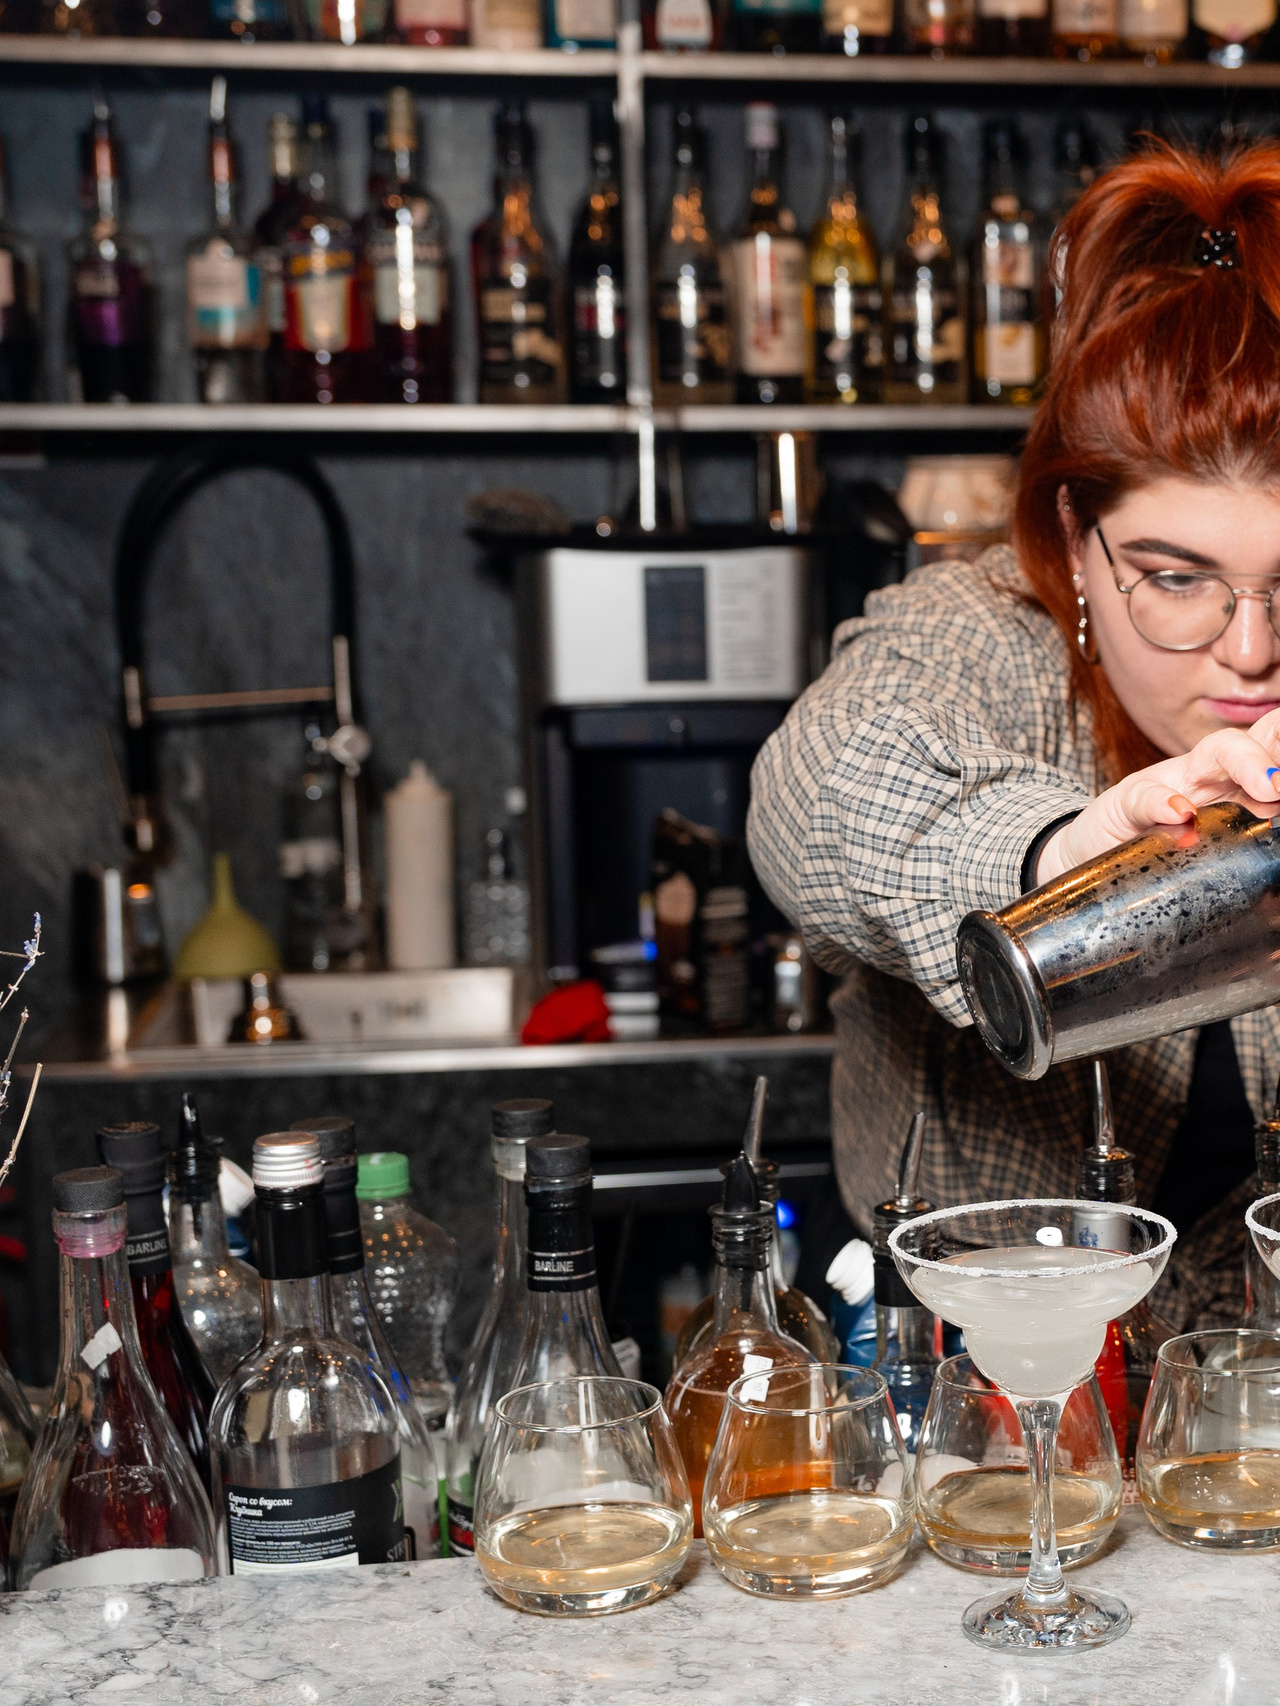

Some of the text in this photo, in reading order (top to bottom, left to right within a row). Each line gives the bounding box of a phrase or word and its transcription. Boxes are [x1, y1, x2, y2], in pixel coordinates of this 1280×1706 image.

[534, 1260, 574, 1272] BARLINE
[229, 1492, 248, 1505] Сироп
[259, 1496, 292, 1510] вкусом:
